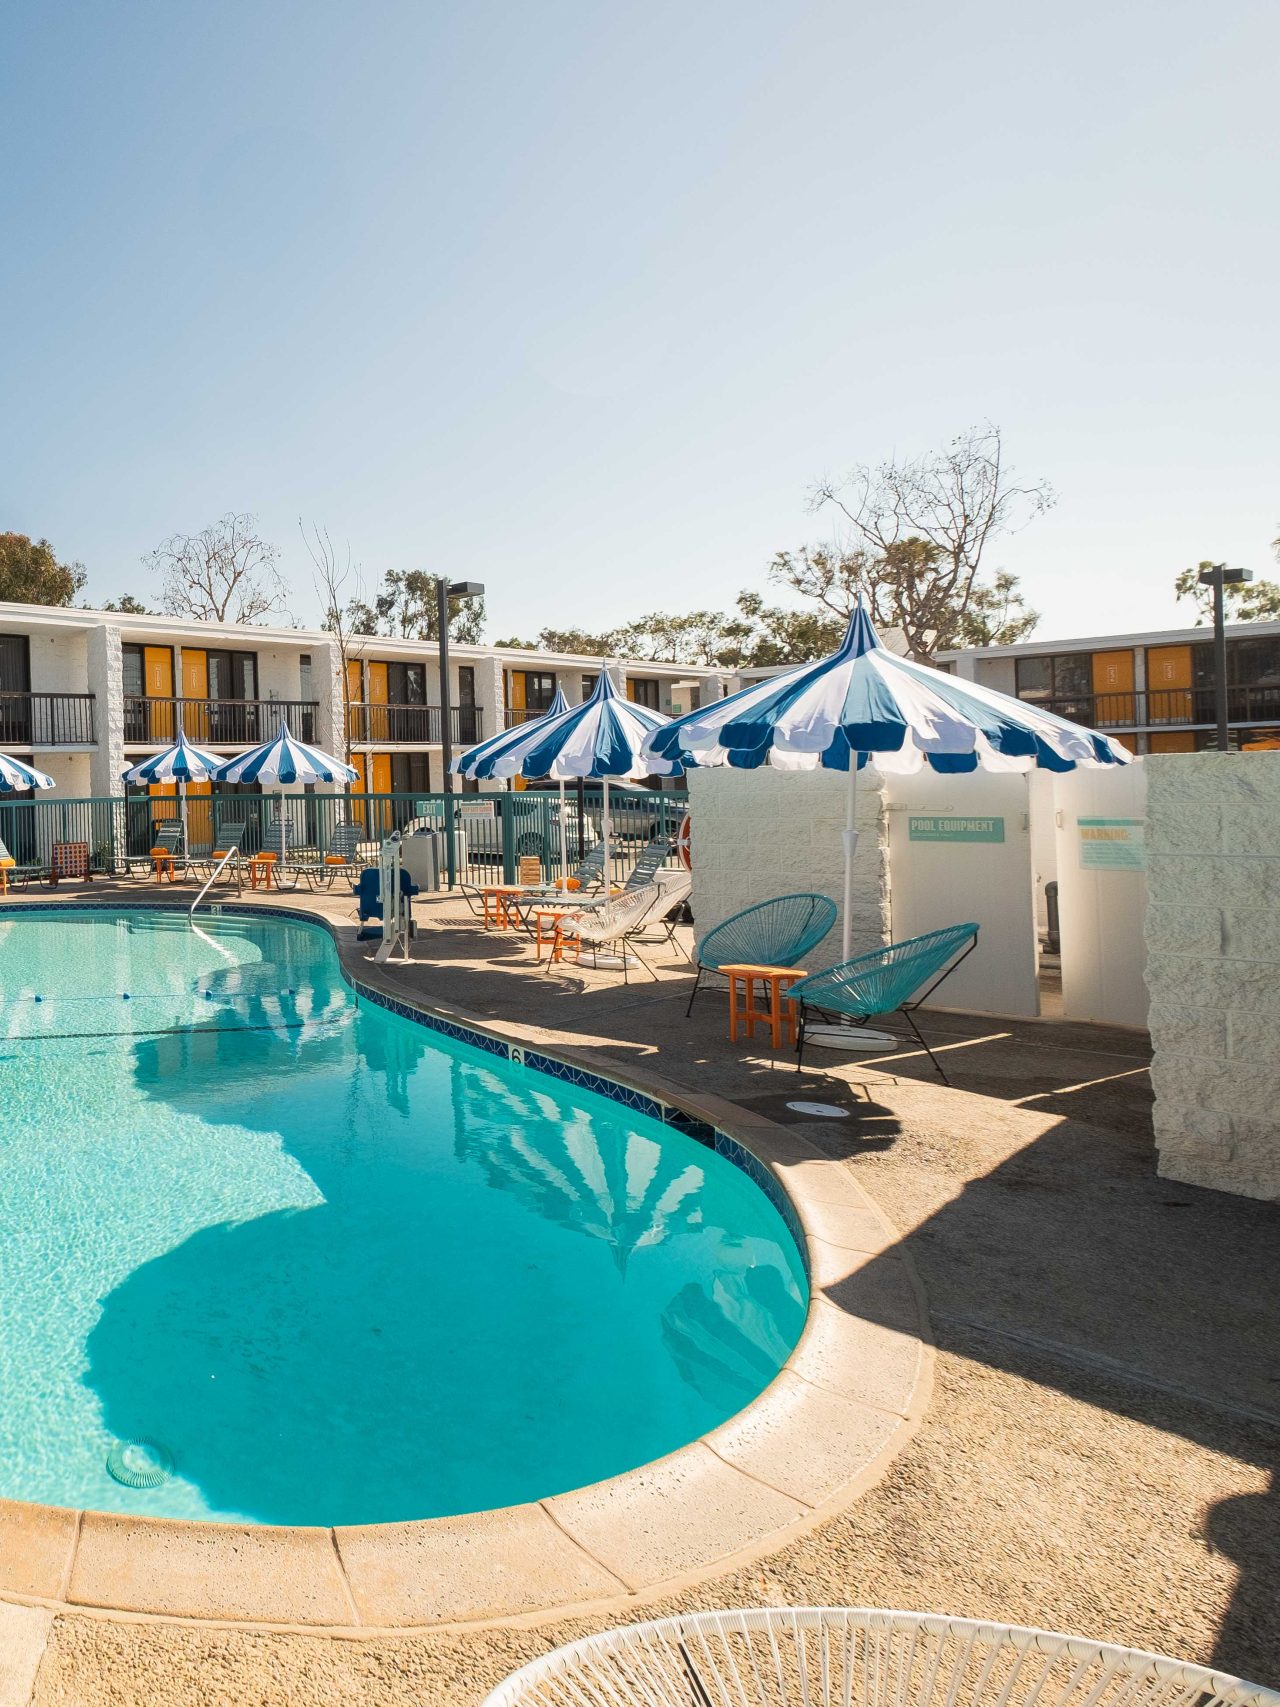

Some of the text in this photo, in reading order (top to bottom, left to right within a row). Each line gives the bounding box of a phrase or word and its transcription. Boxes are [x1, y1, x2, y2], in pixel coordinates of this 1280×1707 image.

[422, 804, 437, 814] EXIT
[911, 820, 995, 832] POOL EQUIPMENT
[511, 1048, 522, 1065] 6
